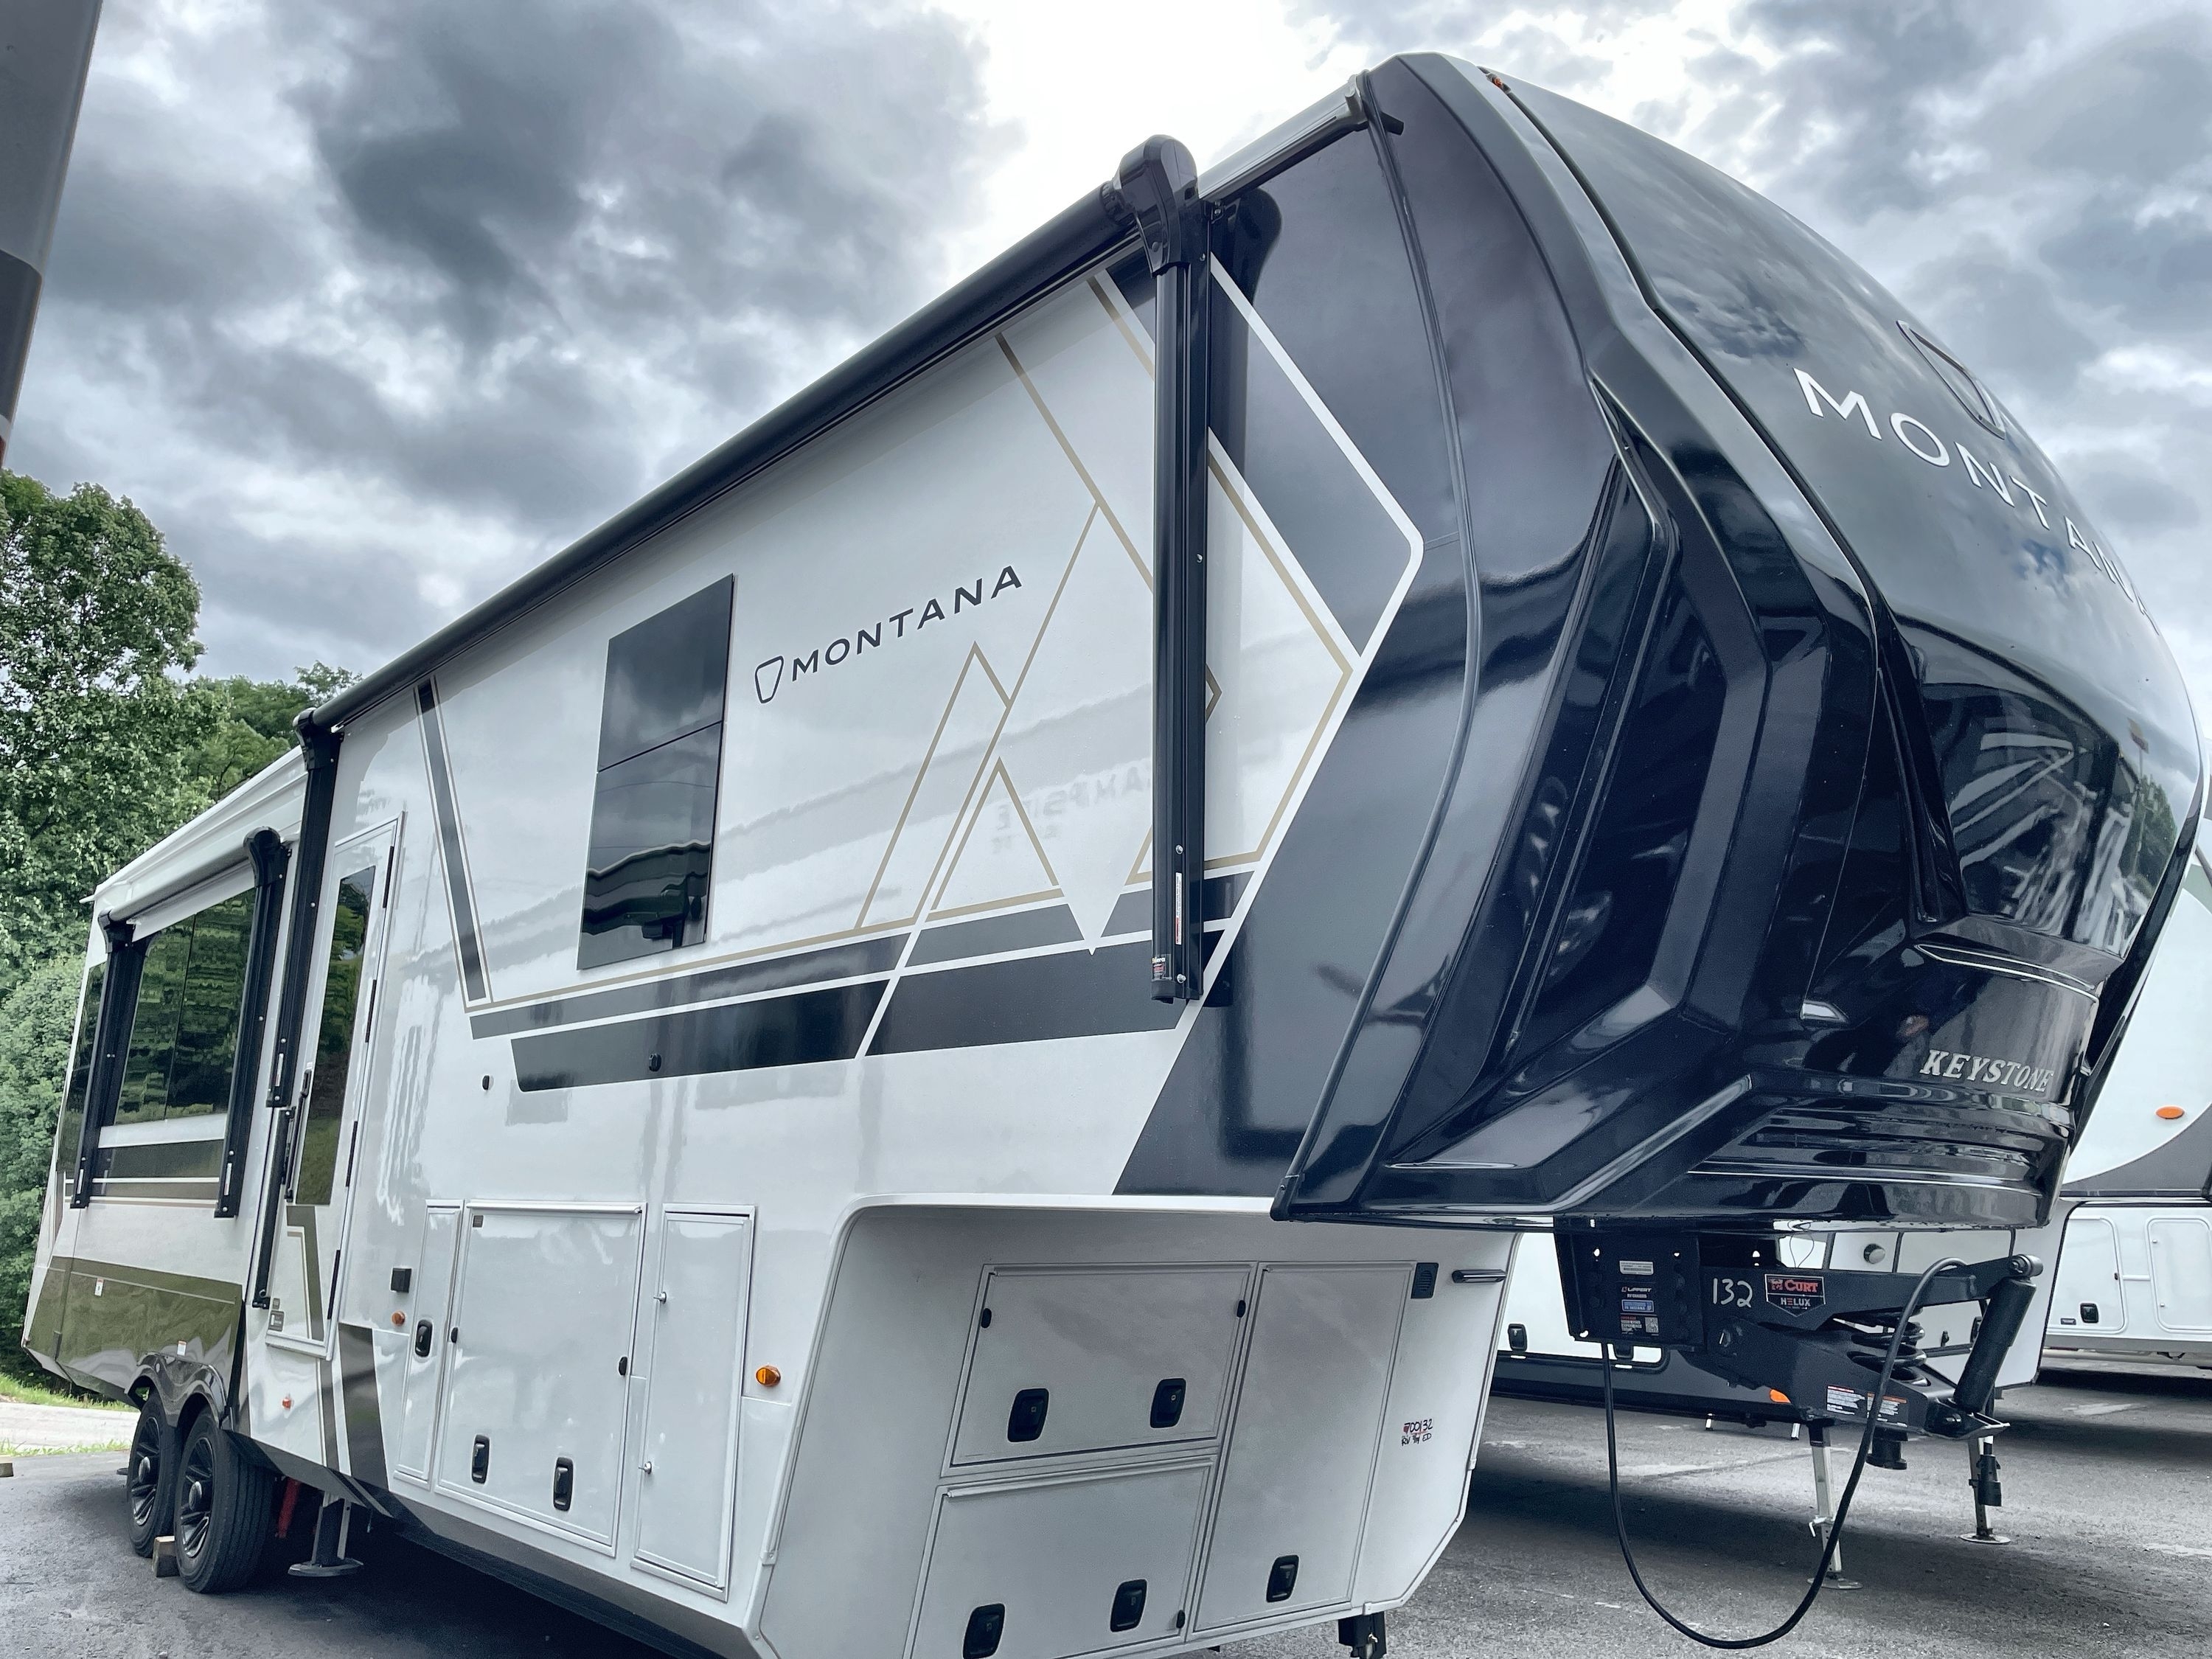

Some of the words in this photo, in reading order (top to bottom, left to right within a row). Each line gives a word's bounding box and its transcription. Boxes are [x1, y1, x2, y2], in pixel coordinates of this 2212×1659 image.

[1792, 367, 2160, 636] MONTANA
[792, 565, 1023, 682] MONTANA
[1919, 1049, 2054, 1092] KEYSTONE
[1713, 1278, 1753, 1308] 132
[1781, 1297, 1811, 1307] HELUX
